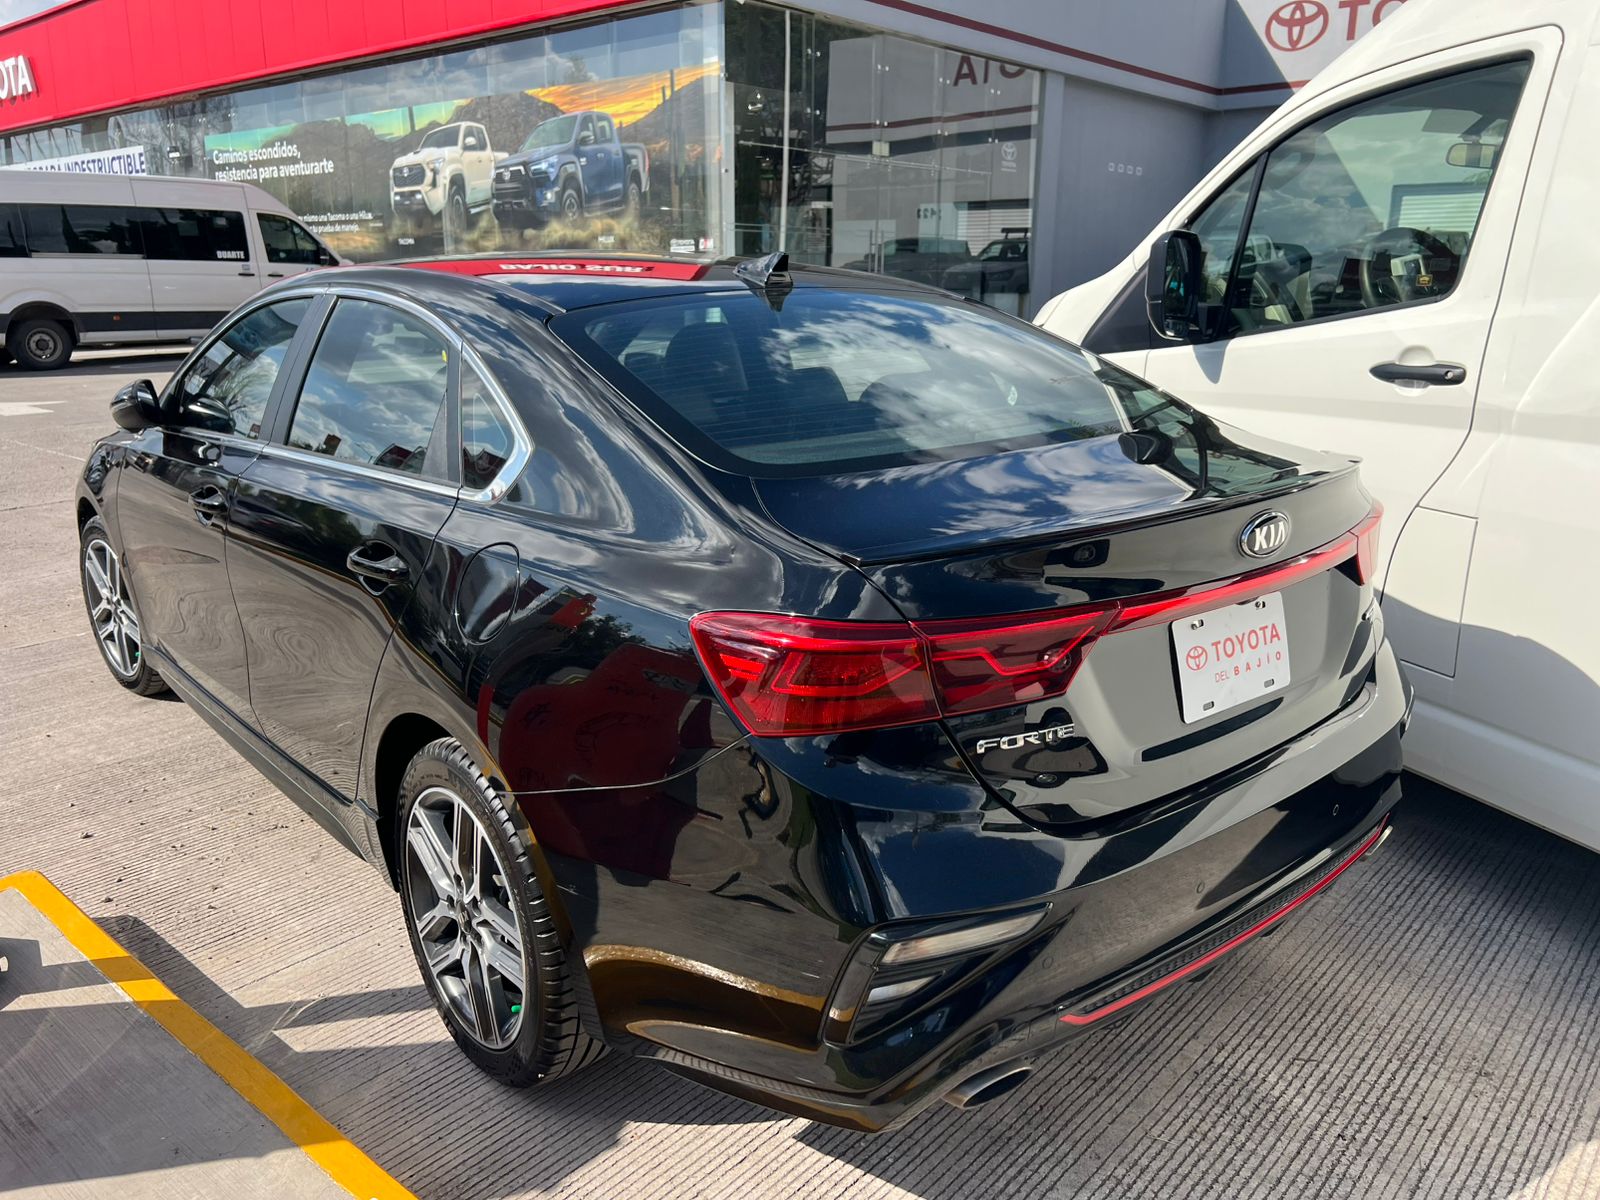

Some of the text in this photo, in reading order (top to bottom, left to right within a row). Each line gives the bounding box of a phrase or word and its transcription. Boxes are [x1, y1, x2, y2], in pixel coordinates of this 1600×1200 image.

[213, 141, 300, 165] Caminos escondidos,
[215, 158, 334, 183] resistencia para aventurarte
[1253, 520, 1285, 551] KIA
[1211, 623, 1281, 662] TOYOTA
[1214, 670, 1229, 683] DEL
[976, 723, 1076, 754] FORTE
